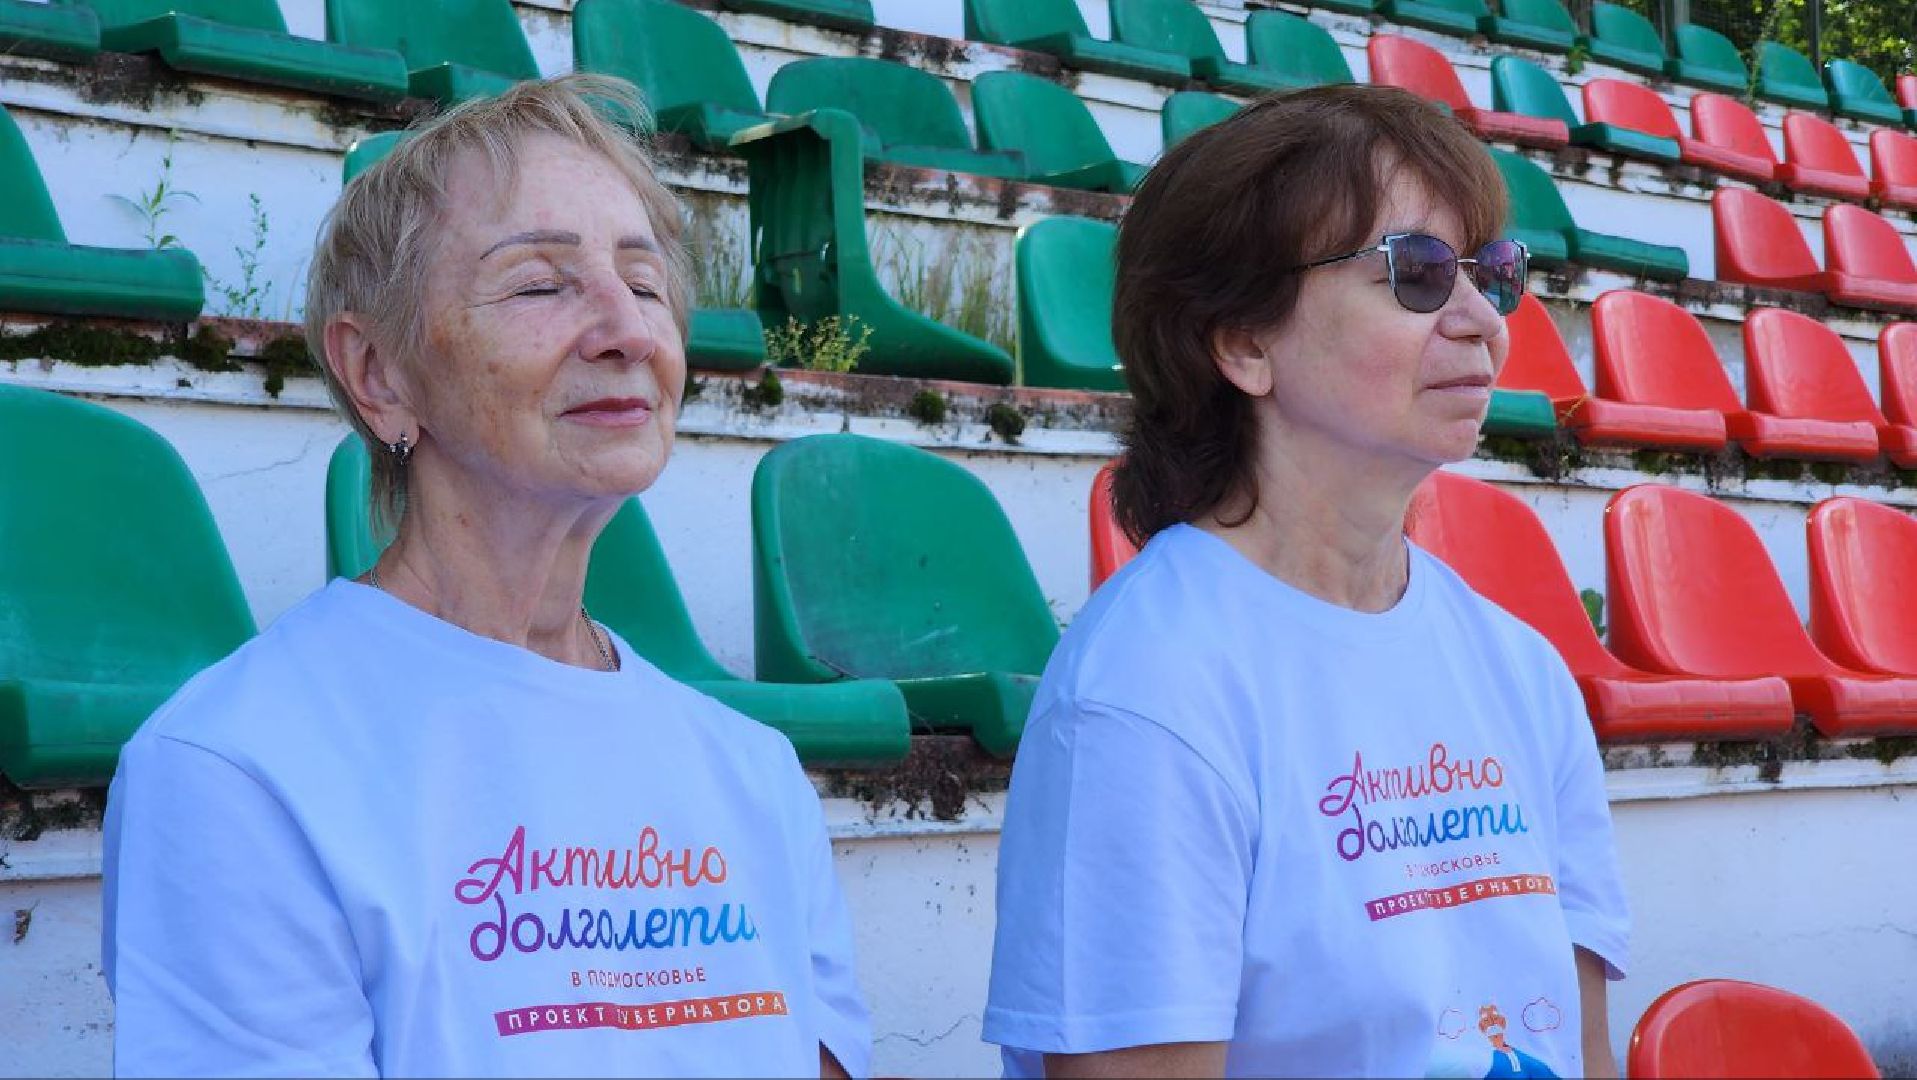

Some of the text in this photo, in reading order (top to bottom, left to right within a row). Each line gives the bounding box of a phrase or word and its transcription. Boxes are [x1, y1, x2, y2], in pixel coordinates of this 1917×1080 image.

[1318, 742, 1503, 817] Активно
[455, 826, 727, 904] Активно
[470, 891, 760, 962] долголети
[571, 966, 706, 988] В ПОДМОСКОВЬЕ
[508, 1006, 605, 1029] ПРОЕКТ
